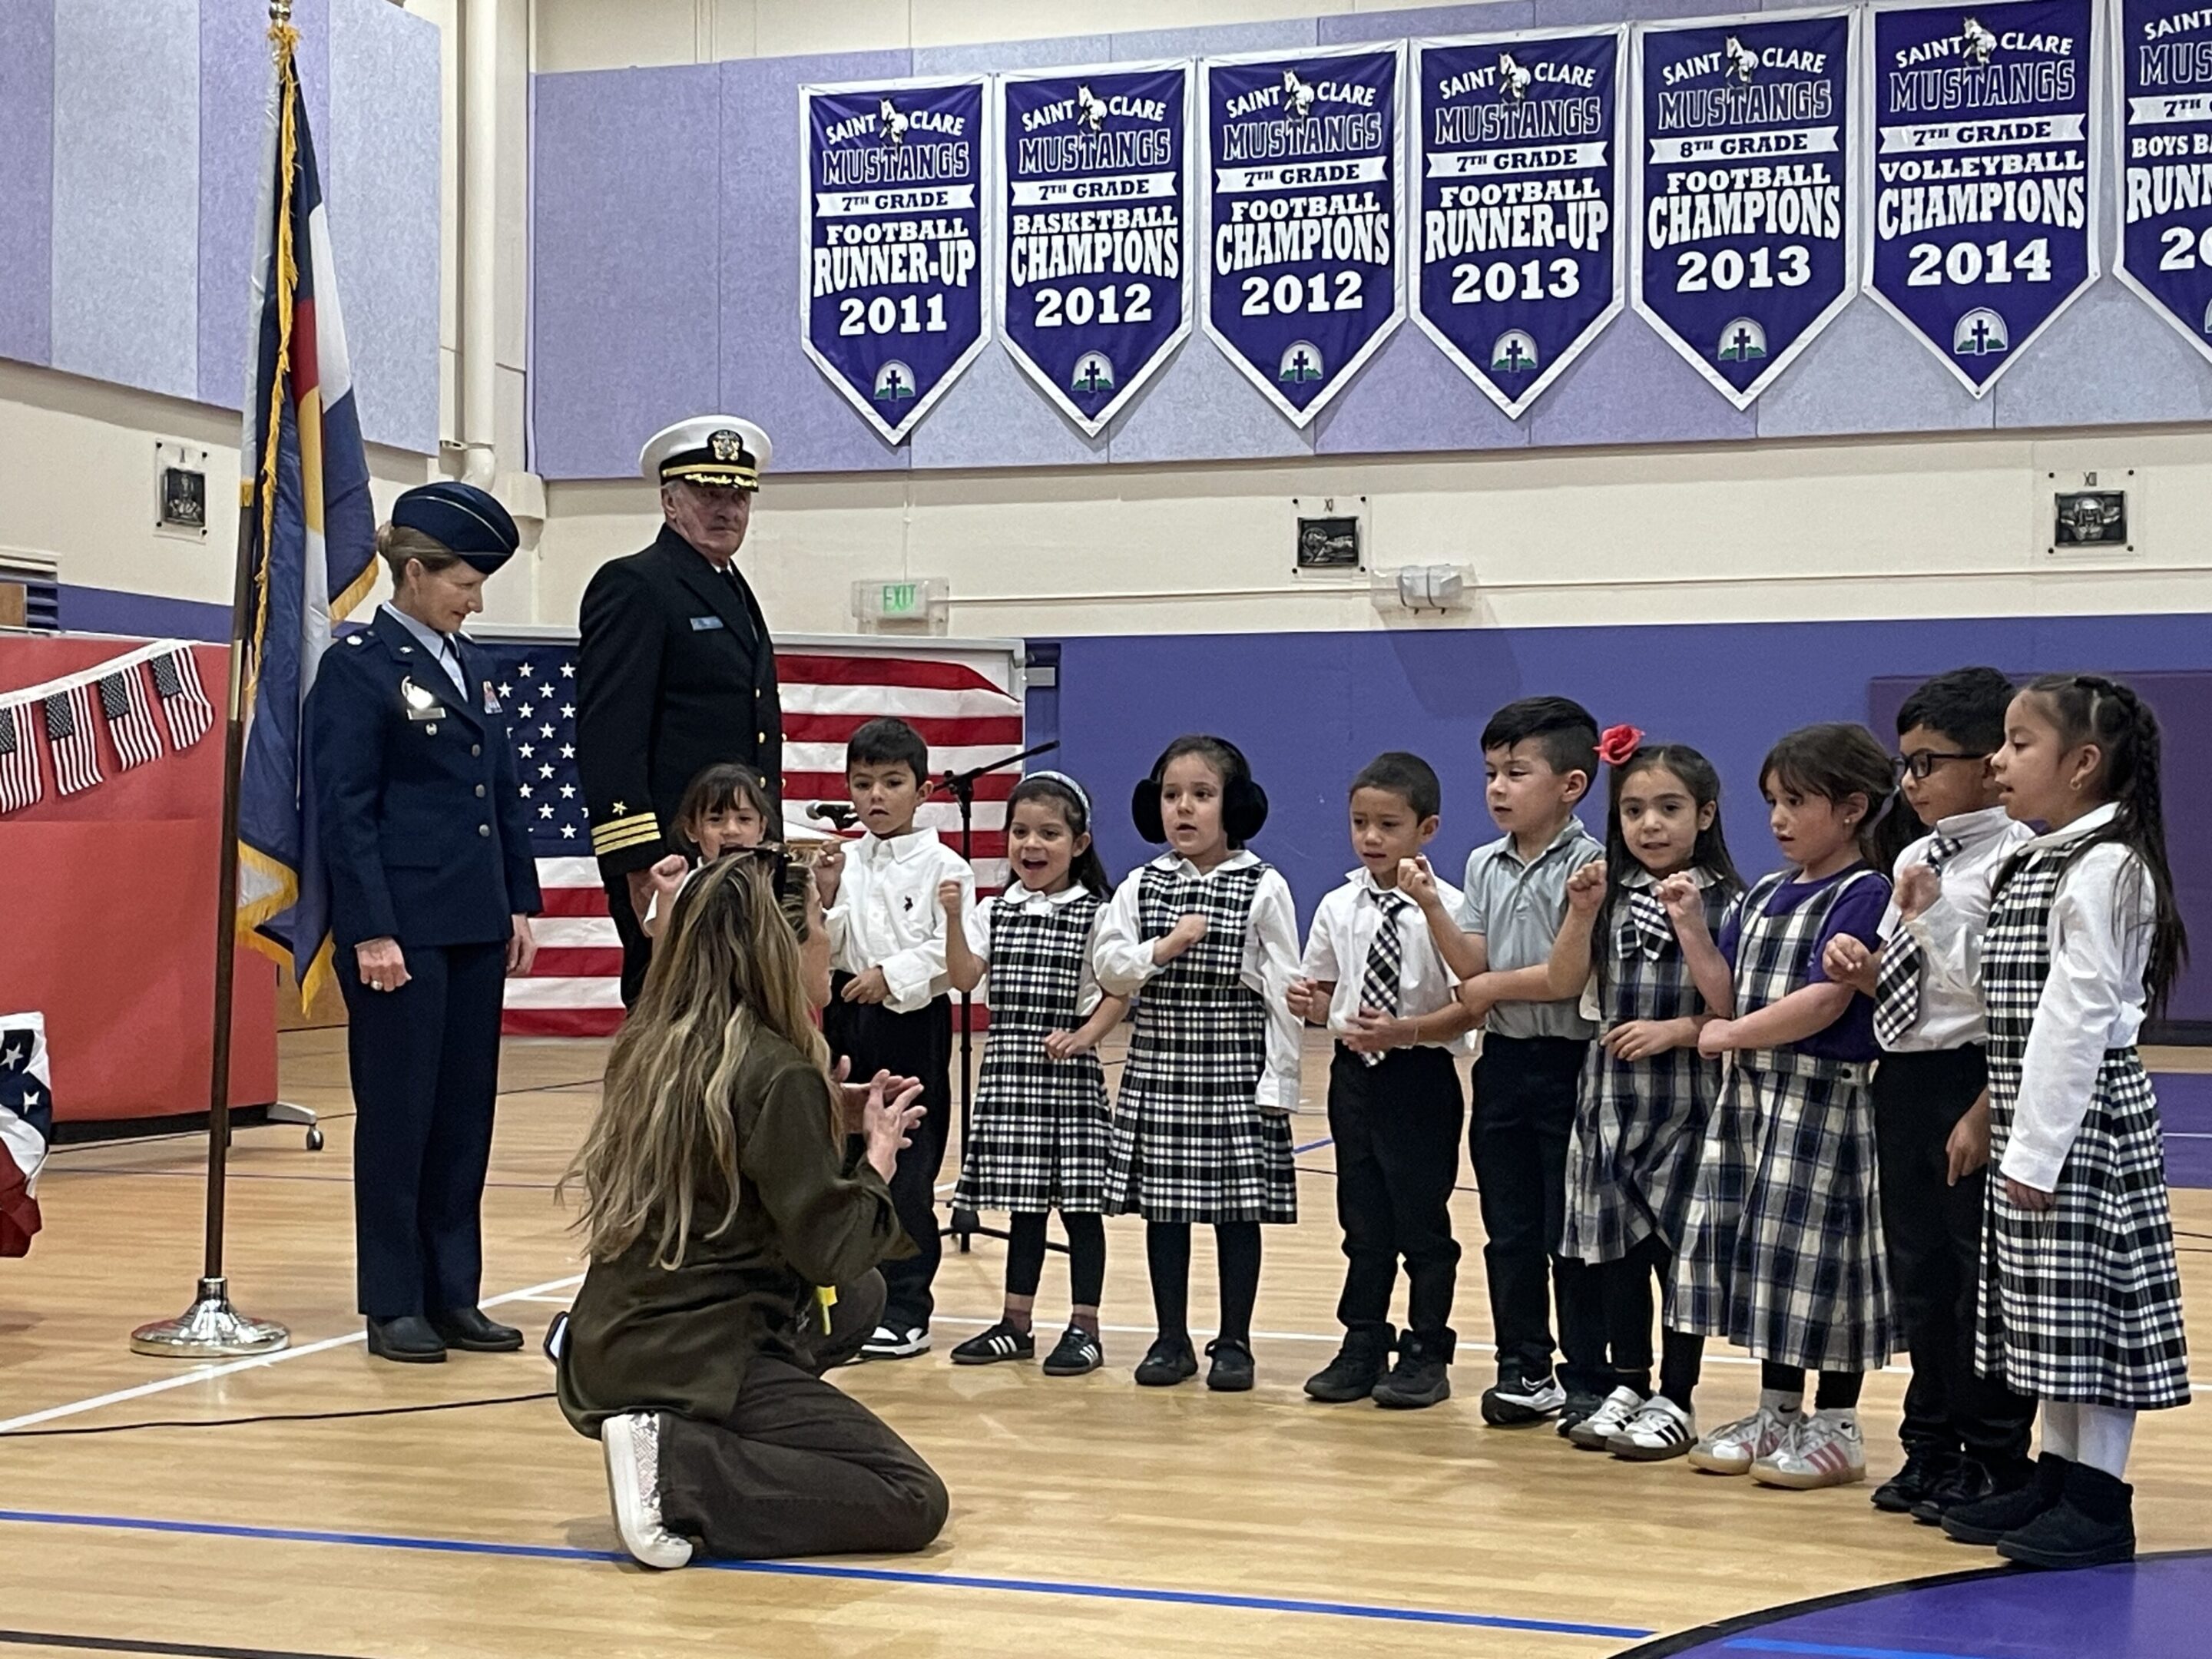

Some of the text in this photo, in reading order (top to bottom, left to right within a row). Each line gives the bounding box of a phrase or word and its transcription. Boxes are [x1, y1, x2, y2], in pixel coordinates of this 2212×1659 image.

[2144, 9, 2212, 41] SAINT
[1662, 47, 1827, 86] SAINT CLARE
[1896, 31, 2074, 68] SAINT CLARE
[1227, 81, 1376, 118] SAINT CLARE
[1439, 61, 1596, 100] SAINT CLARE
[1889, 59, 2076, 112] MUSTANGS
[1022, 96, 1167, 132] SAINT CLARE
[1435, 96, 1601, 144] MUSTANGS
[1657, 80, 1833, 130] MUSTANGS
[2164, 99, 2200, 118] 7TH
[826, 111, 966, 145] SAINT CLARE
[1223, 112, 1382, 161] MUSTANGS
[1680, 134, 1808, 158] 8TH GRADE
[1912, 121, 2052, 146] 7TH GRADE
[823, 142, 969, 186] MUSTANGS
[1018, 128, 1171, 174] MUSTANGS
[1456, 150, 1578, 172] 7TH GRADE
[1878, 149, 2085, 182] VOLLEYBALL
[2131, 136, 2188, 159] BOYS
[1038, 179, 1150, 200] 7TH GRADE
[1244, 164, 1360, 187] 7TH GRADE
[1440, 177, 1601, 208] FOOTBALL
[1667, 162, 1831, 194] FOOTBALL
[843, 191, 949, 212] 7TH GRADE
[1012, 205, 1178, 235] BASKETBALL
[1231, 191, 1380, 222] FOOTBALL
[1648, 184, 1841, 250] CHAMPIONS
[1878, 176, 2085, 241] CHAMPIONS
[826, 218, 969, 245] FOOTBALL
[1216, 213, 1390, 276] CHAMPIONS
[1425, 200, 1609, 263] RUNNER-UP
[813, 238, 976, 298] RUNNER-UP
[1011, 228, 1179, 287] CHAMPIONS
[1677, 245, 1811, 293] 2013
[1907, 238, 2051, 286] 2014
[1241, 270, 1363, 316] 2012
[1452, 257, 1581, 304] 2013
[839, 293, 947, 336] 2011
[1035, 283, 1152, 327] 2012
[882, 584, 916, 611] EXIT
